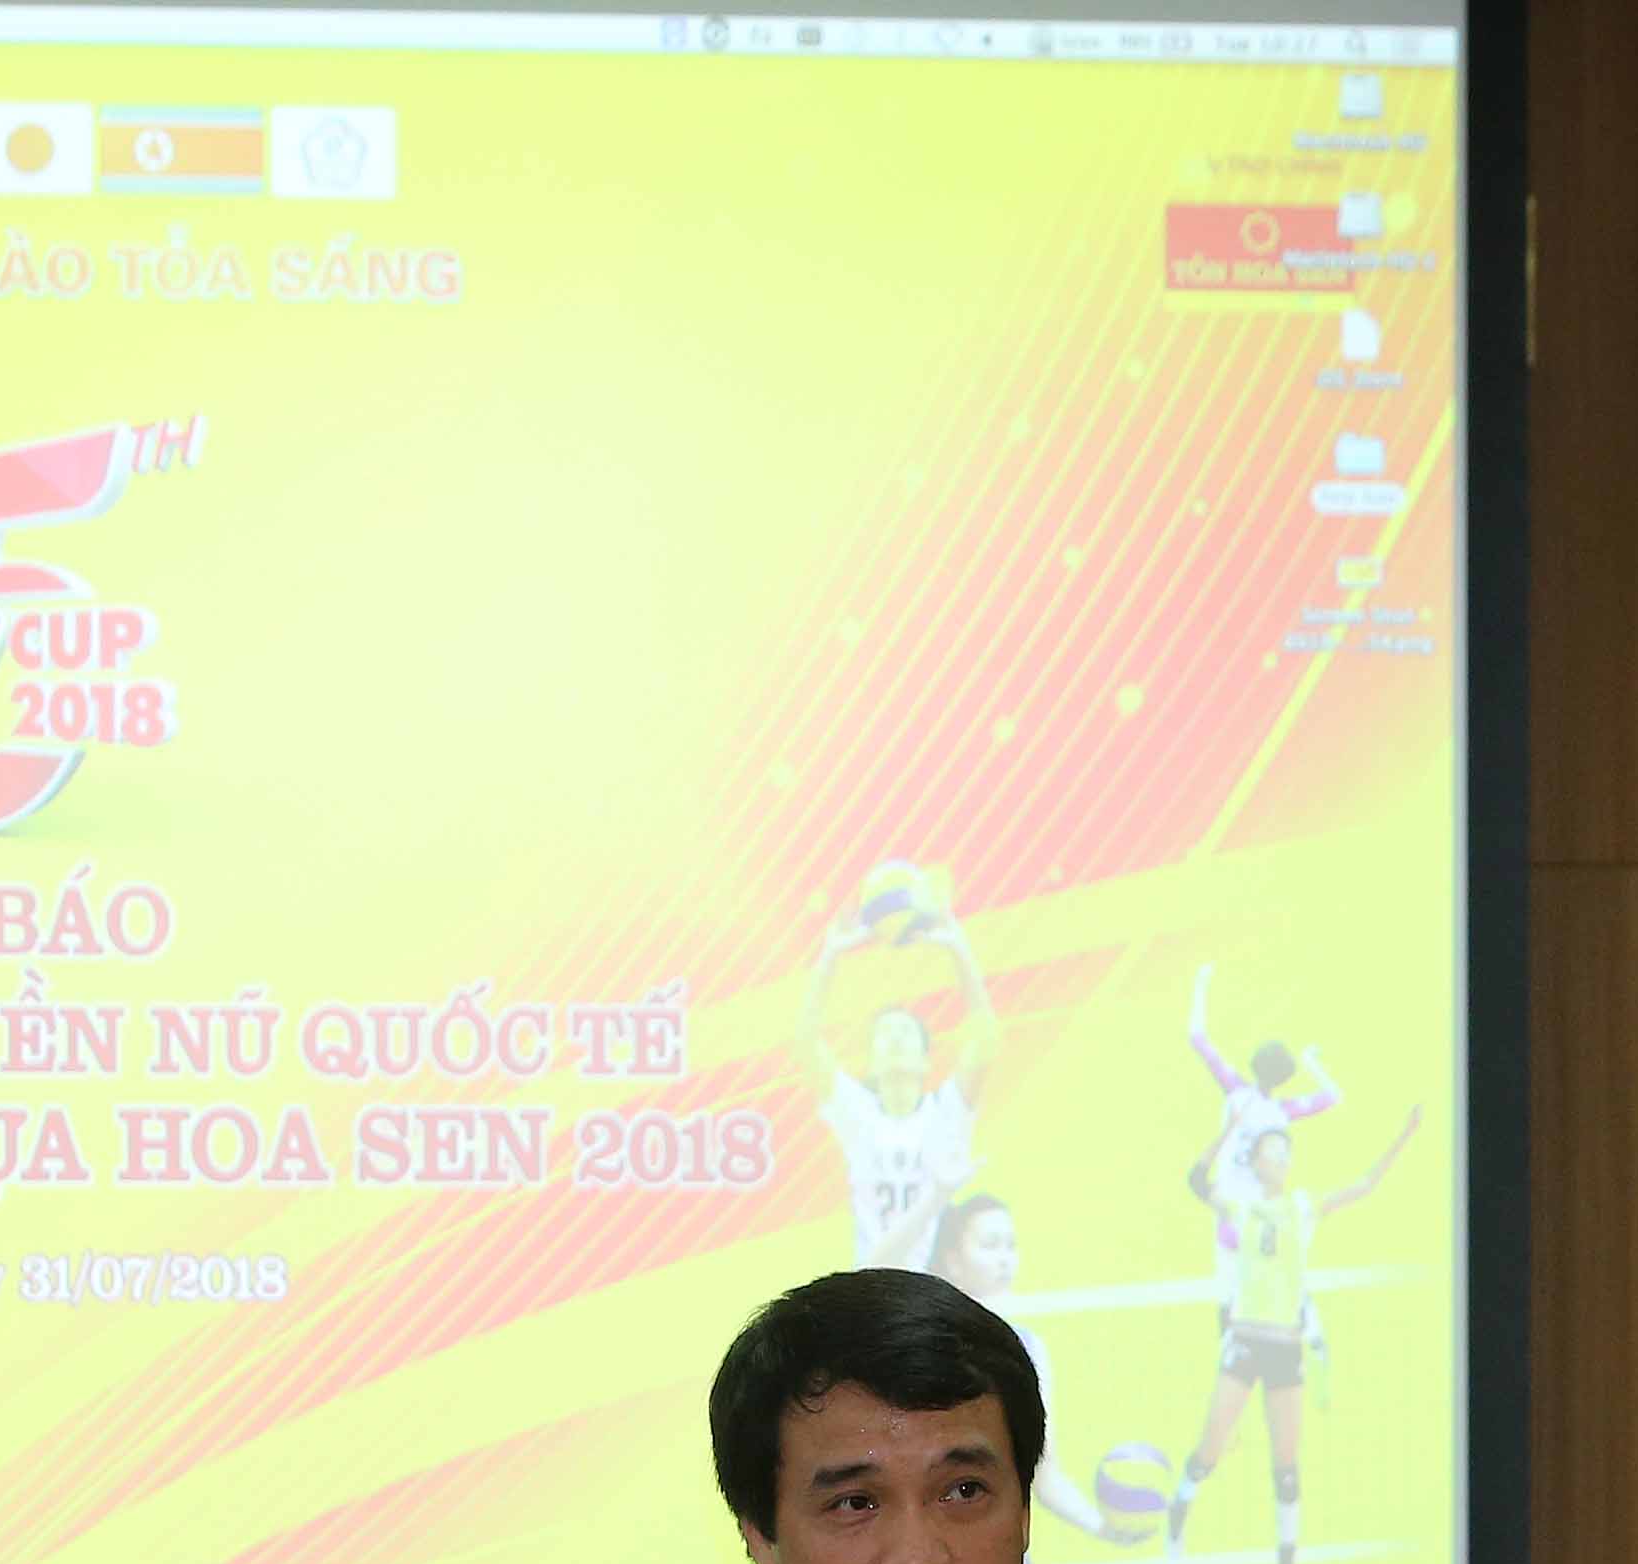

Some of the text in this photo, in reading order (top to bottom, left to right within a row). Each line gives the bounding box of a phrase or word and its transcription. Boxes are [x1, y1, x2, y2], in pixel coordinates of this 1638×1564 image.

[9, 609, 149, 672] CUP
[10, 681, 171, 748] 2018
[150, 990, 280, 1076] NỮ
[302, 983, 551, 1078] QUỐC
[572, 984, 686, 1076] TẾ
[116, 1109, 329, 1183] HOA
[357, 1109, 551, 1184] SEN
[575, 1113, 773, 1185] 2018
[18, 1253, 289, 1304] 31/07/2018
